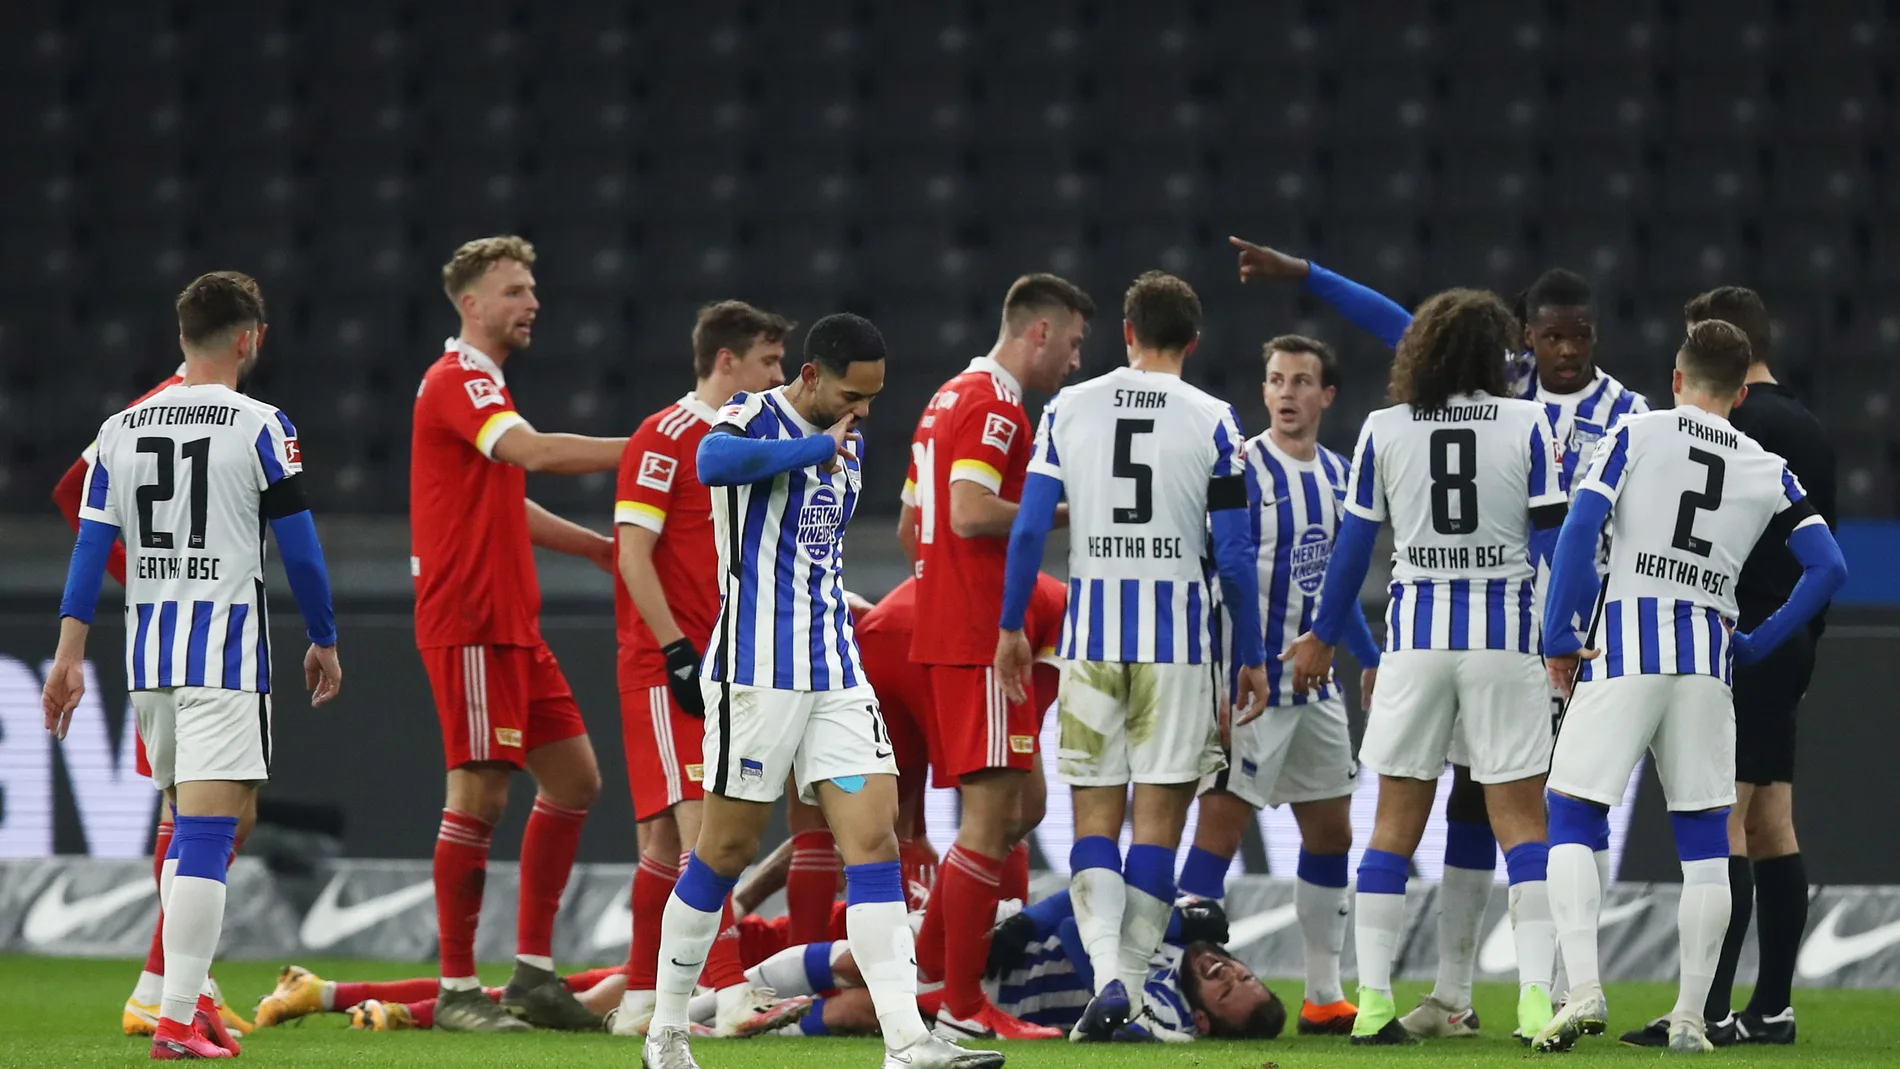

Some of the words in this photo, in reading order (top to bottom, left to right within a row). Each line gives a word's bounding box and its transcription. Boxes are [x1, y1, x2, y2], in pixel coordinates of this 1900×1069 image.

[1113, 389, 1167, 408] STARK
[1678, 416, 1738, 450] PEKARIK
[1112, 418, 1154, 524] 5
[1430, 429, 1478, 535] 8
[136, 436, 211, 549] 21
[1671, 446, 1726, 558] 2
[800, 506, 843, 527] HERTHA
[1088, 536, 1145, 559] HERTHA
[1153, 537, 1182, 559] BSC
[1407, 545, 1469, 569] HERTHA
[1475, 545, 1506, 568] BSC
[136, 556, 182, 580] ERTH
[187, 557, 220, 581] BSC
[1635, 552, 1699, 587] HERTHA
[1701, 569, 1730, 597] BSC
[866, 704, 892, 746] 1
